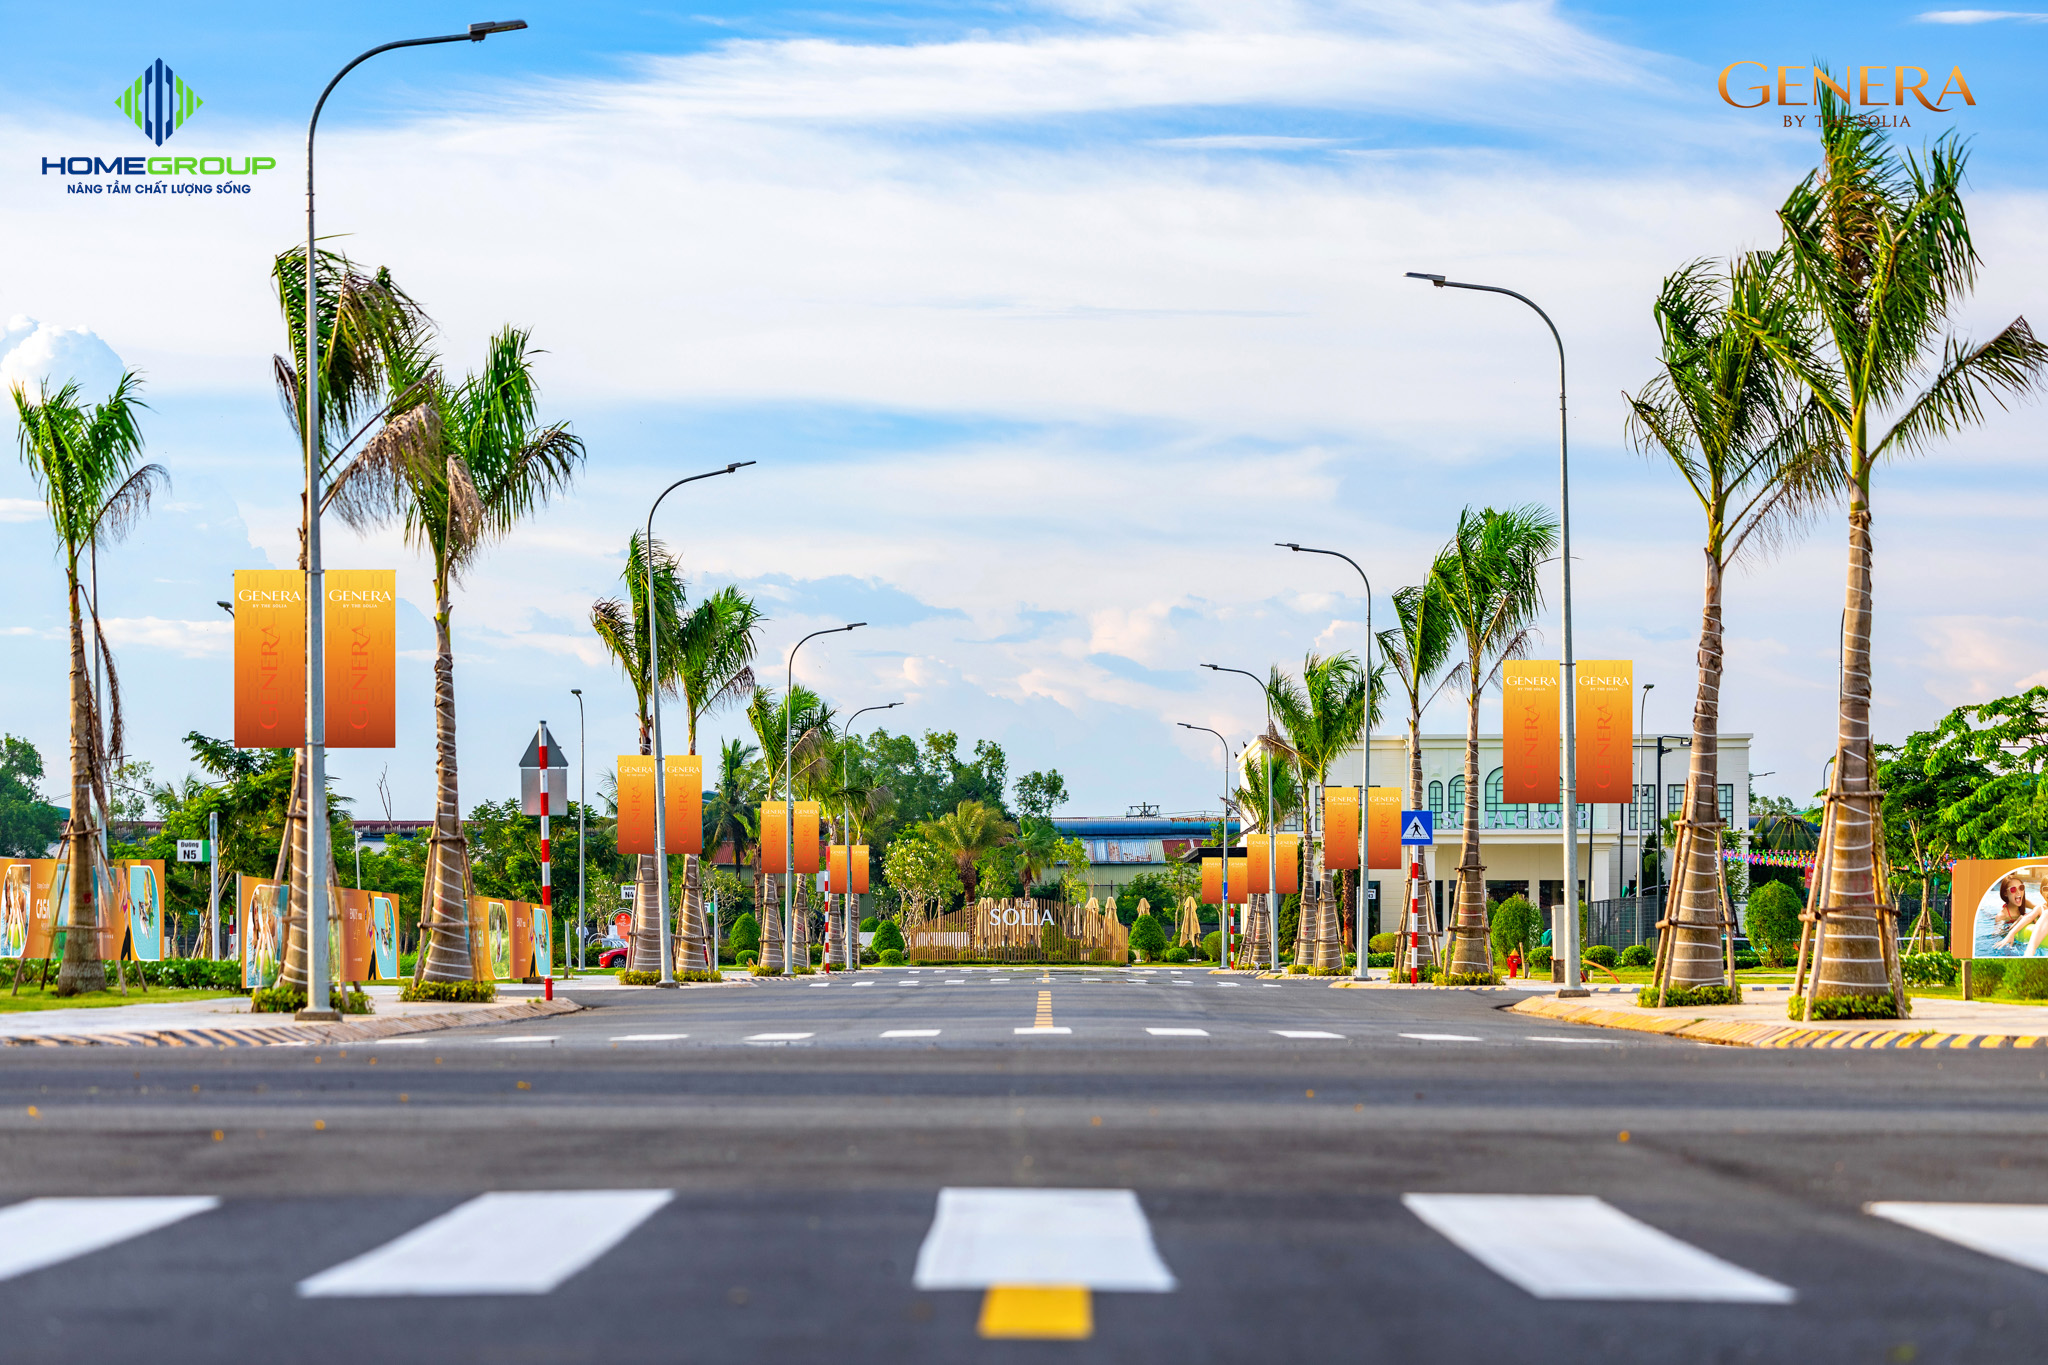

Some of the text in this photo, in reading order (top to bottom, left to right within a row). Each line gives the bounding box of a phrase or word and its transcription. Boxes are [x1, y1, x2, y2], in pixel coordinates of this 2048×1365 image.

[238, 589, 301, 602] GENERA
[329, 589, 391, 602] GENERA
[259, 624, 281, 729] GENERA
[350, 624, 371, 729] GENERA
[1506, 676, 1557, 686] GENERA
[1579, 676, 1630, 686] GENERA
[1523, 704, 1540, 788] GENERA
[1595, 704, 1613, 788] GENERA
[1440, 811, 1590, 828] SOIA GROP
[183, 850, 196, 859] N5
[990, 908, 1055, 926] SOLIA
